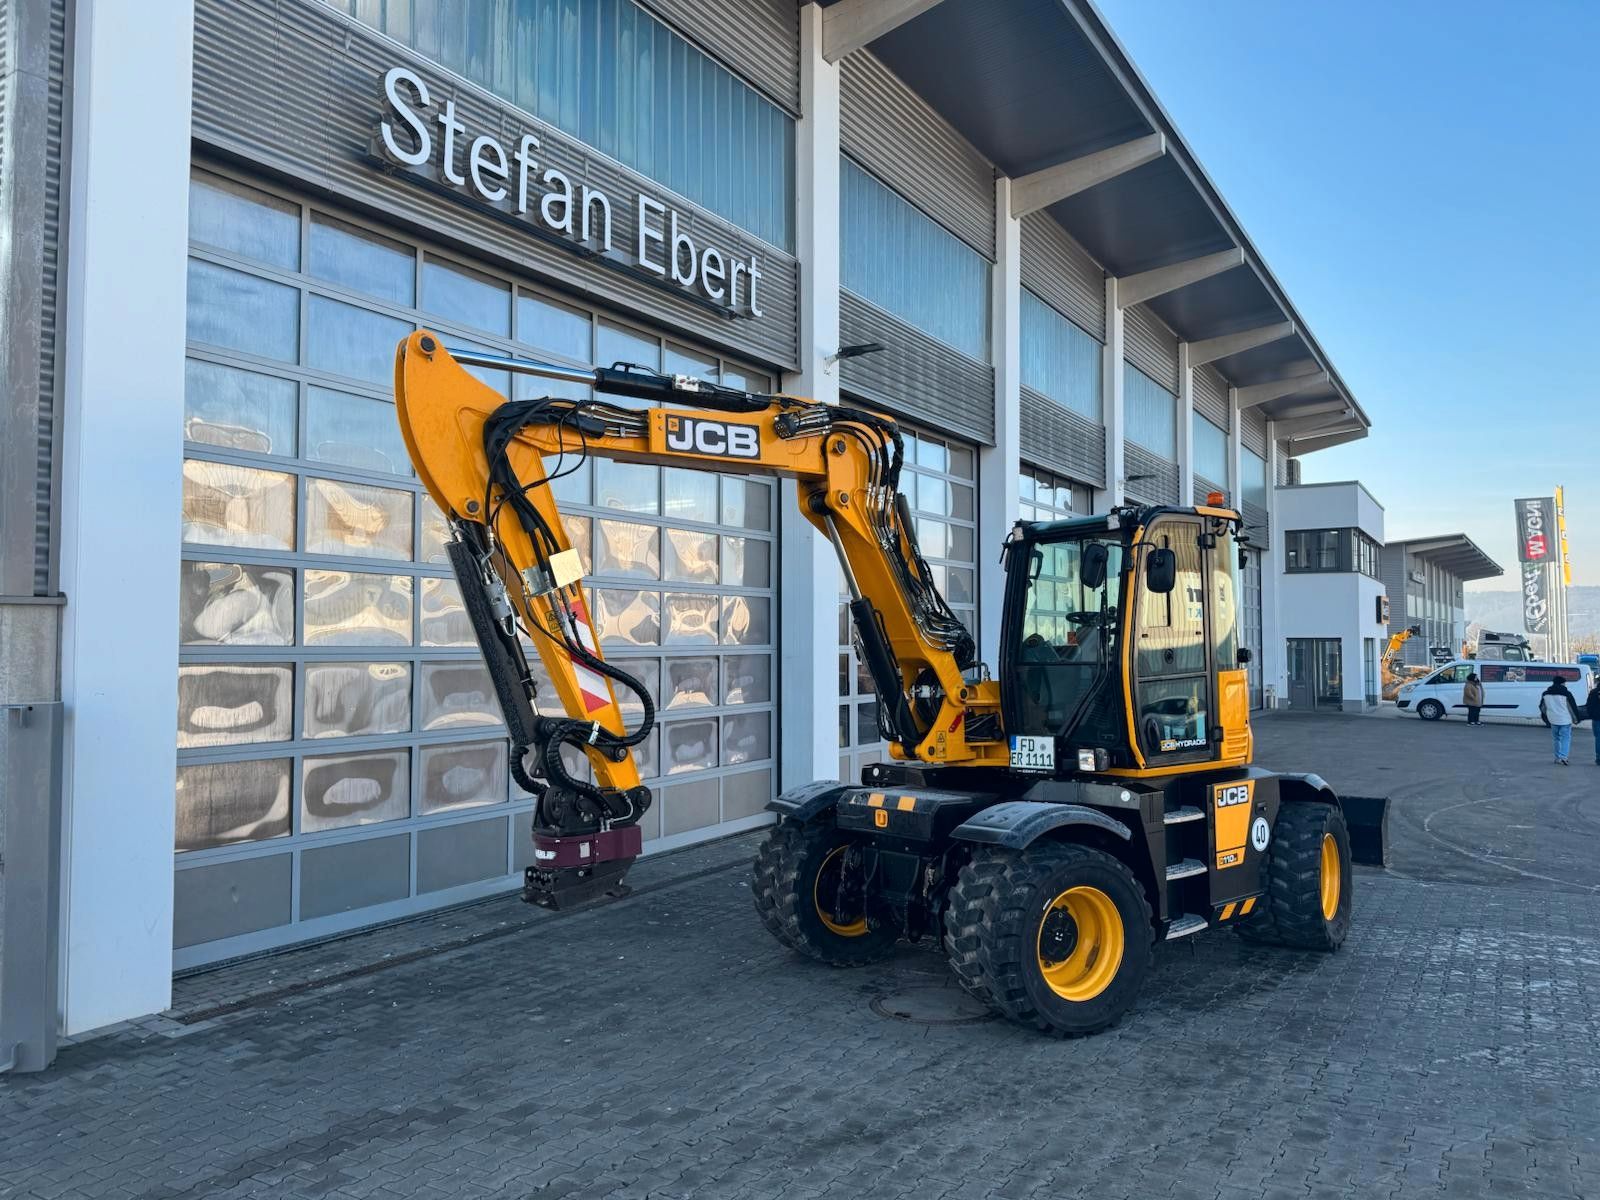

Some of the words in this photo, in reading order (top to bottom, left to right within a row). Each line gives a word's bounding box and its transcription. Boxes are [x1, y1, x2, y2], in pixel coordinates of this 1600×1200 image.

[381, 67, 612, 251] Stefan
[638, 193, 762, 317] Ebert
[667, 419, 759, 457] JCB
[1021, 739, 1034, 751] FD
[1011, 752, 1022, 765] ER
[1025, 753, 1053, 766] 1111
[1217, 785, 1249, 807] JCB
[1256, 823, 1266, 845] 40
